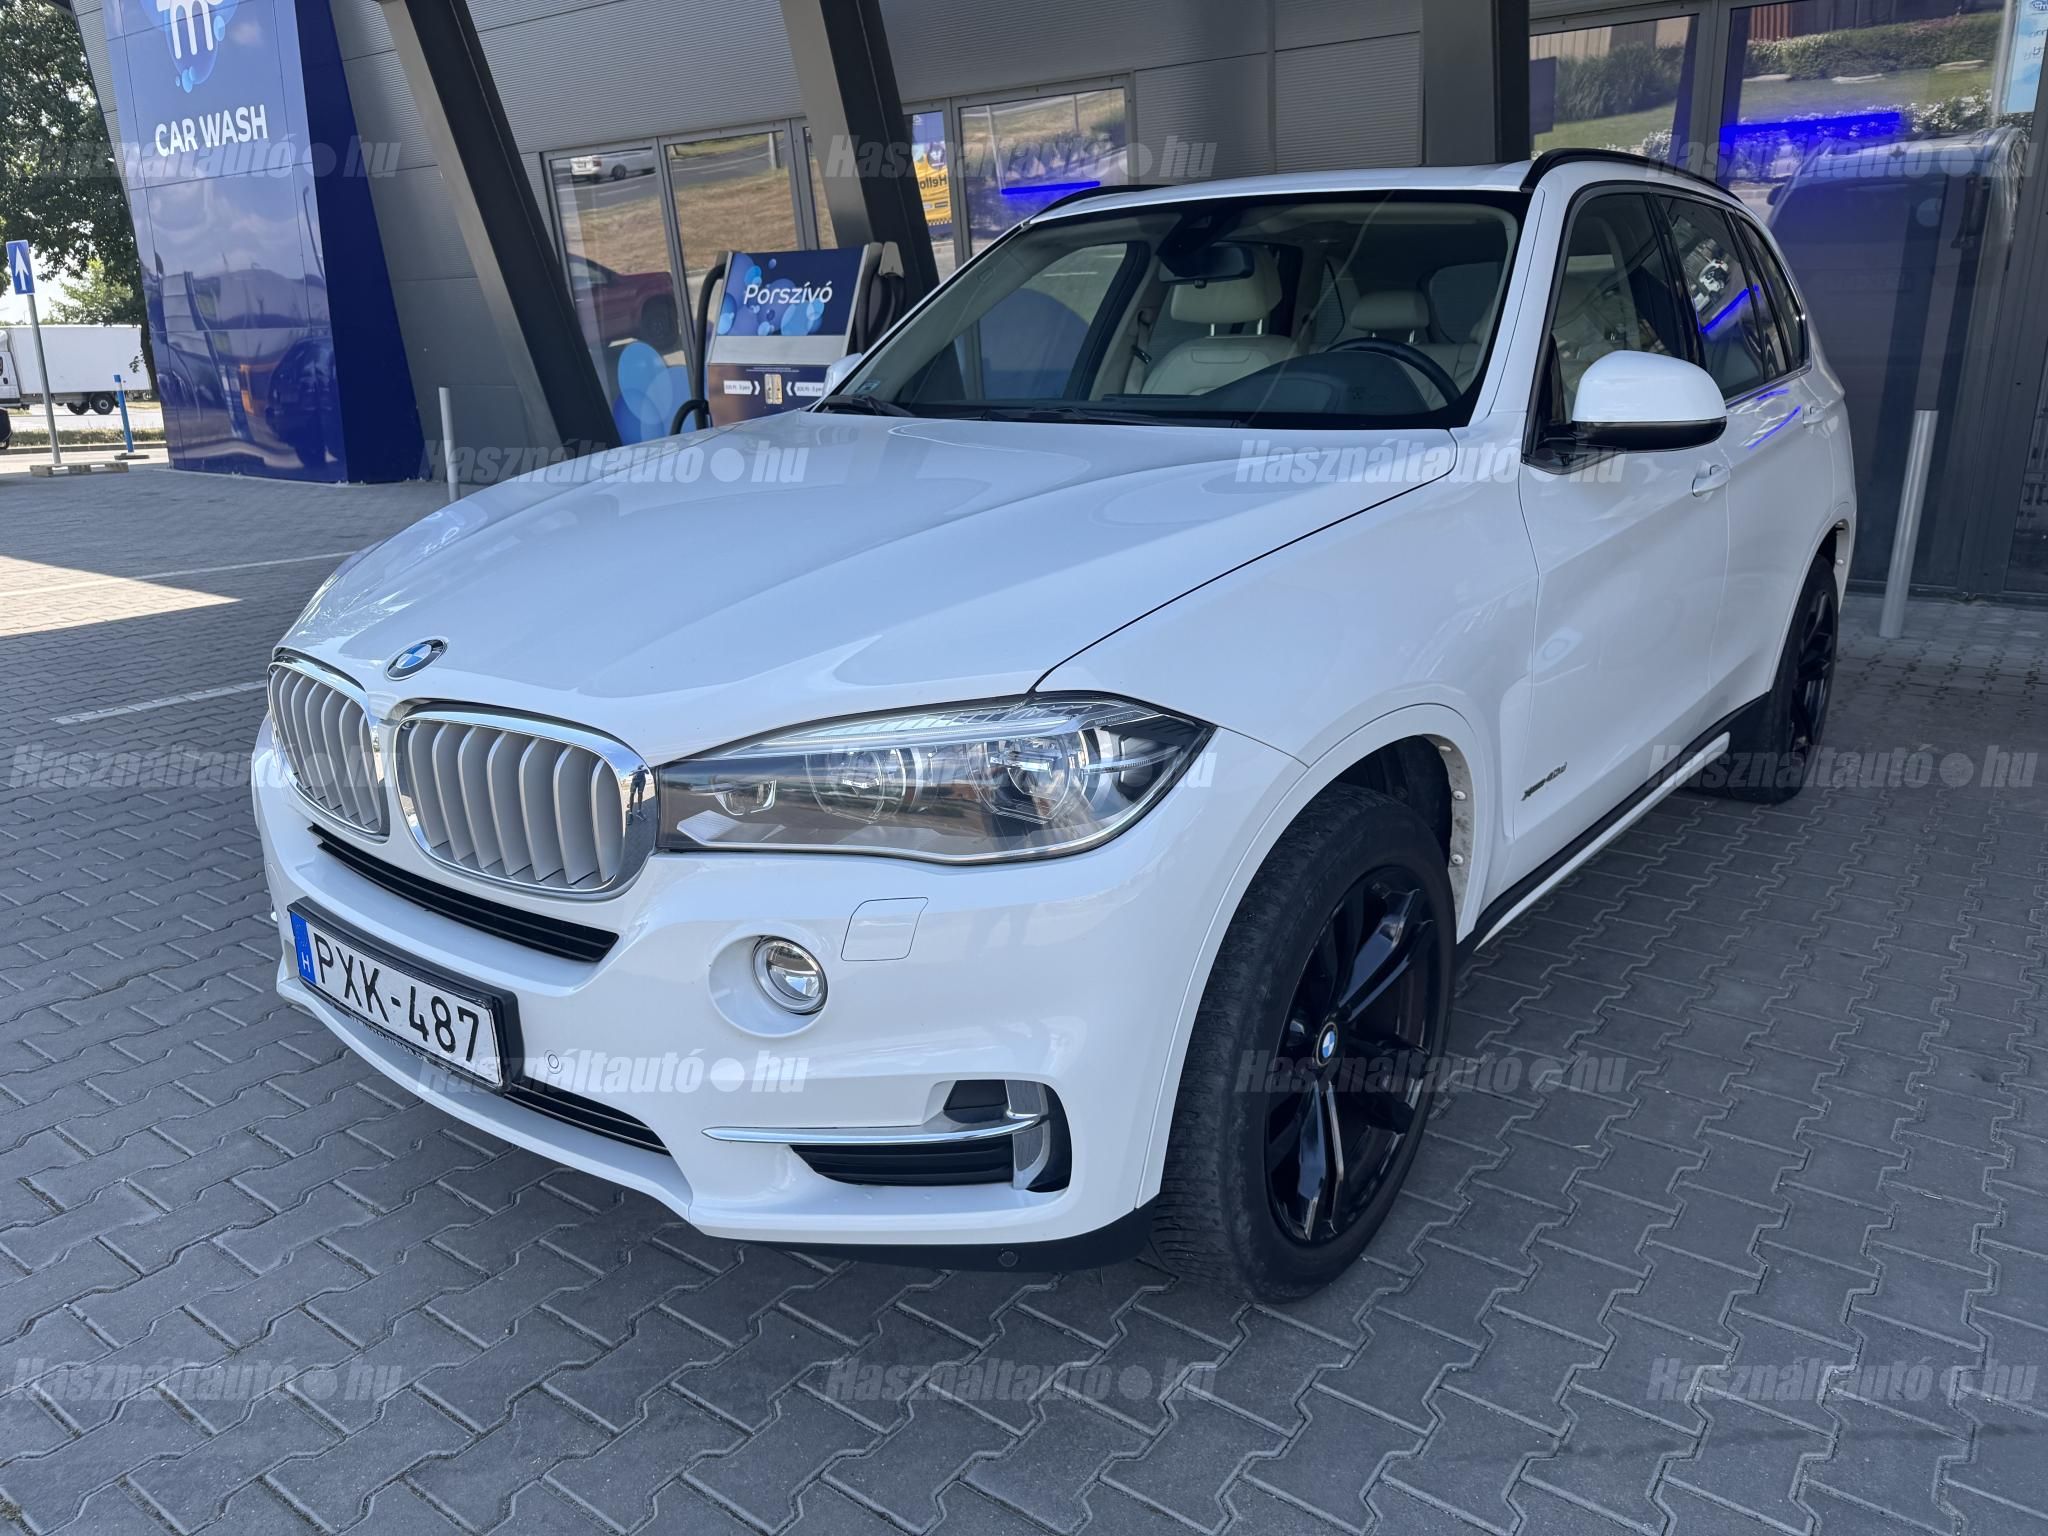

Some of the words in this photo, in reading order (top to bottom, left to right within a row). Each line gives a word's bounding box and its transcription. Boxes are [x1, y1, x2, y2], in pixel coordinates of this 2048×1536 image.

[155, 118, 199, 157] CAR
[199, 104, 269, 148] WASH
[743, 280, 833, 305] Porszívó
[301, 951, 311, 973] H
[313, 932, 480, 1063] PXK-487
